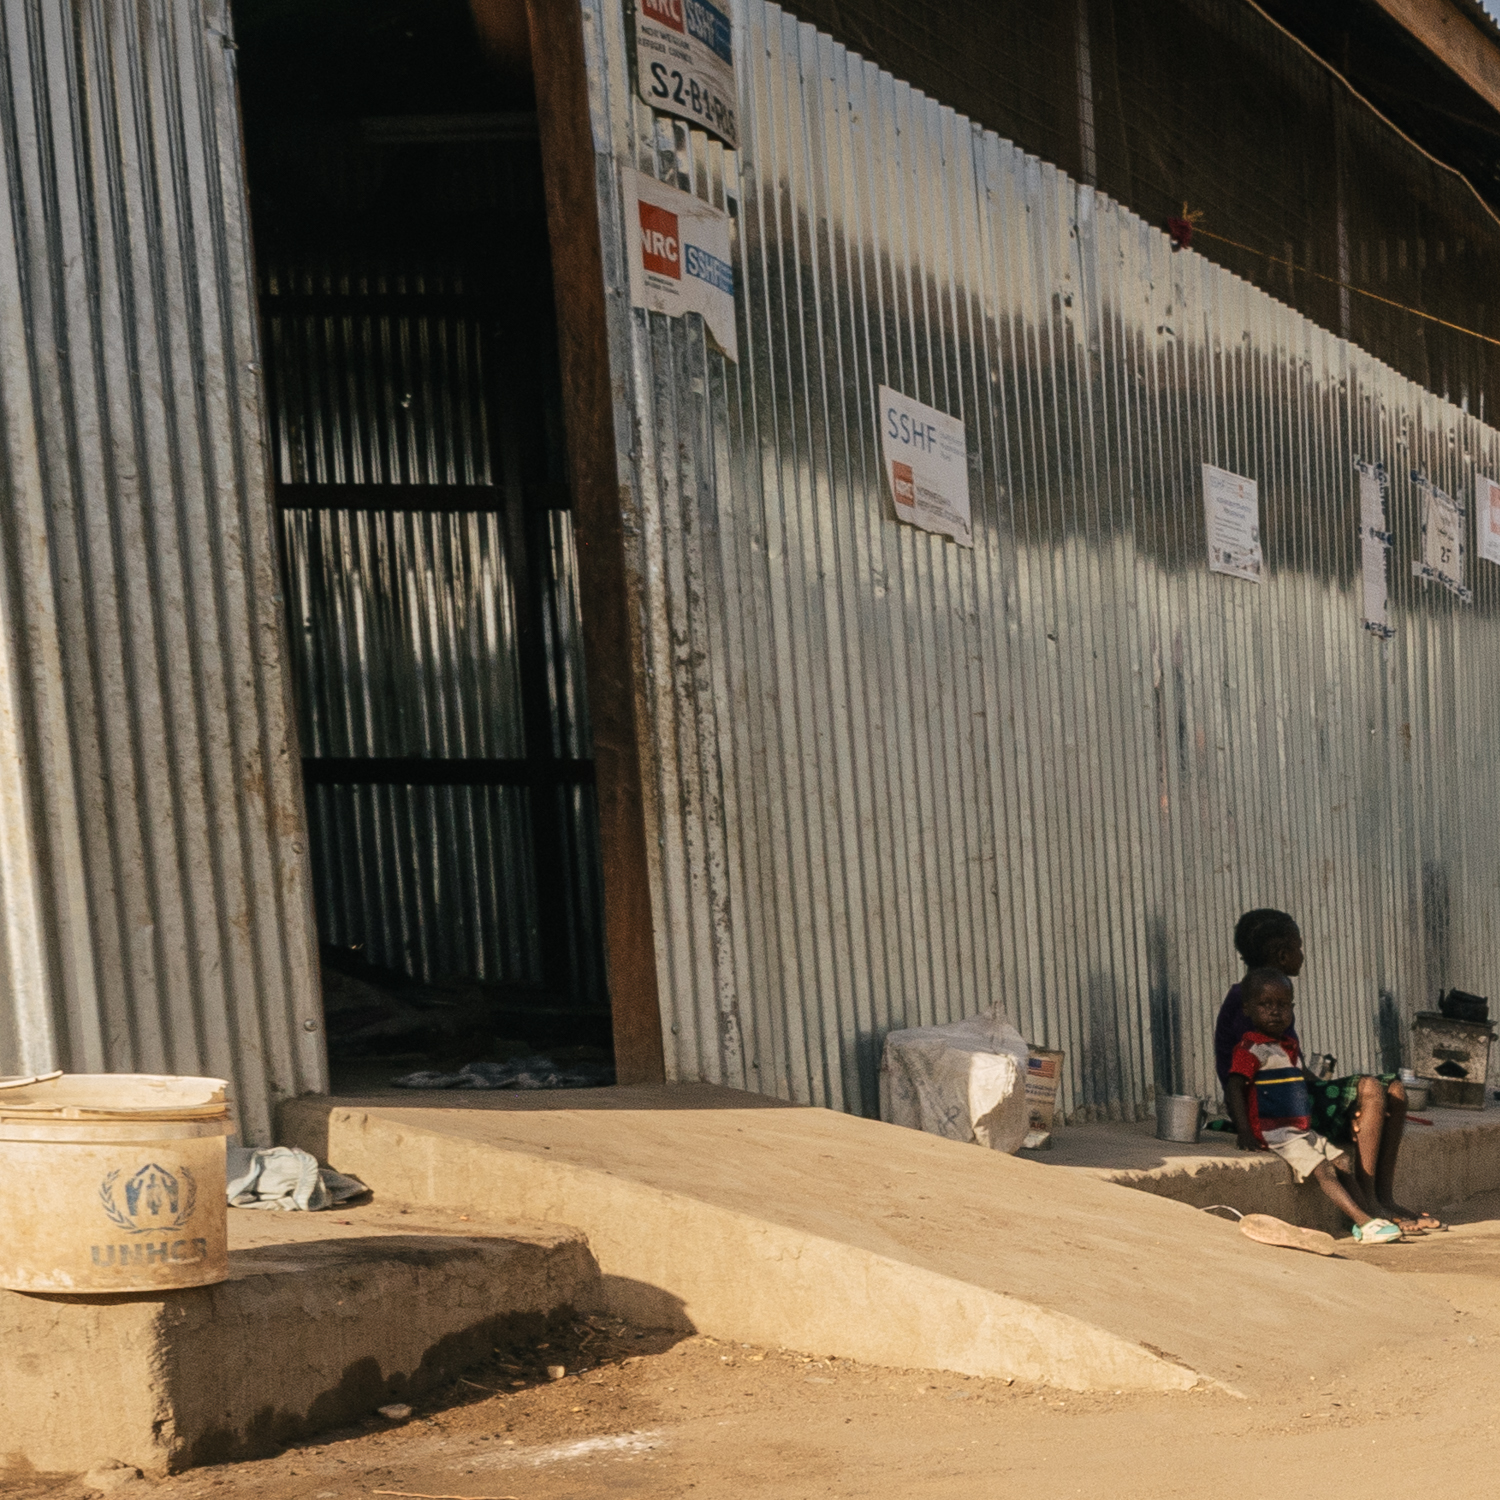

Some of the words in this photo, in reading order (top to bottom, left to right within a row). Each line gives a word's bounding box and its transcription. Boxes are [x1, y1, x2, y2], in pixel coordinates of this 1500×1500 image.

[641, 228, 679, 262] NRC
[887, 407, 936, 453] SSHF
[91, 1238, 207, 1267] UNHCR
